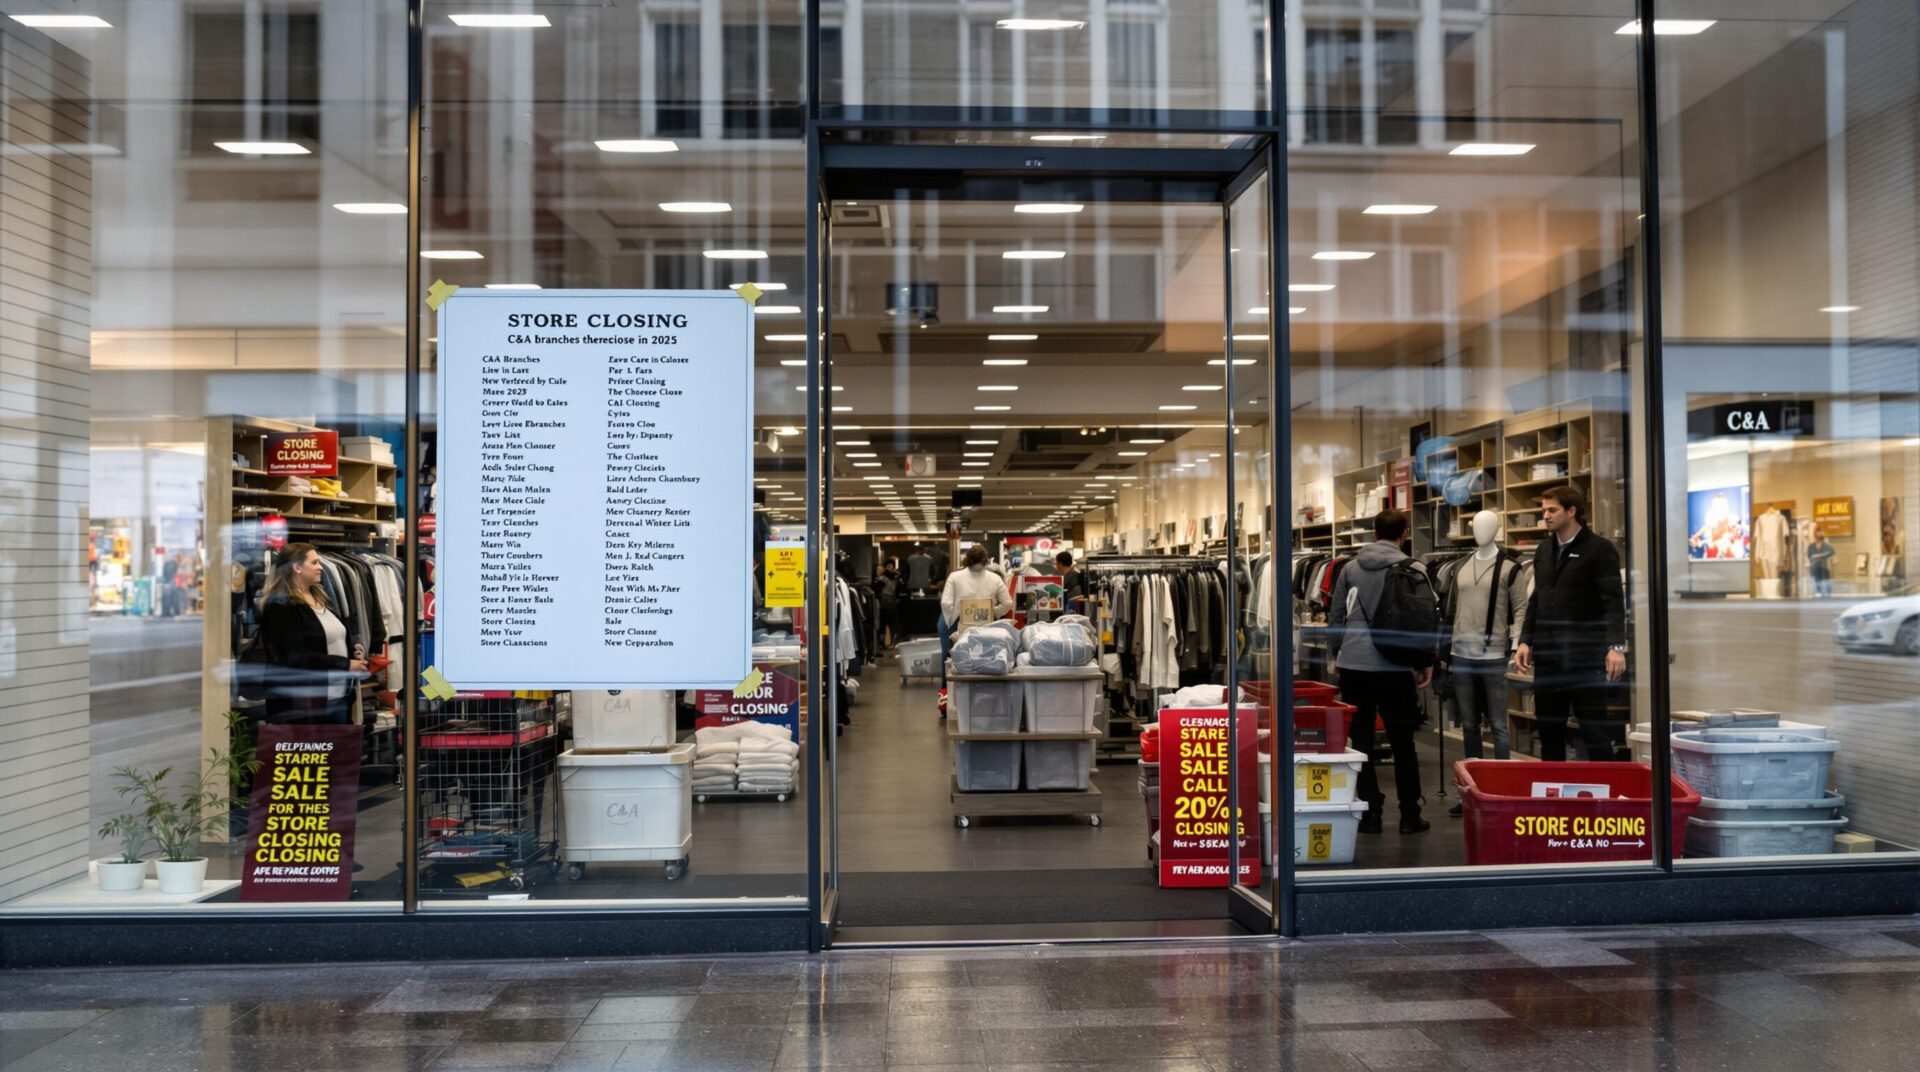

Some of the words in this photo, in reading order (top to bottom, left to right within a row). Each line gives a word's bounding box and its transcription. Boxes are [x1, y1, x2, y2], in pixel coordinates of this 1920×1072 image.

[508, 313, 578, 328] STORE
[587, 313, 689, 329] CLOSING
[508, 335, 531, 344] C&A
[535, 334, 580, 345] branches
[638, 335, 648, 344] in
[652, 335, 677, 345] 2025
[537, 377, 546, 386] by
[1727, 411, 1770, 430] C&A
[283, 438, 318, 449] STORE
[277, 450, 324, 460] CLOSING
[730, 703, 789, 715] CLOSING
[1180, 742, 1229, 758] SALE
[274, 753, 330, 765] STARRE
[272, 766, 331, 782] SALE
[1180, 760, 1229, 775] SALE
[271, 784, 330, 800] SALE
[1183, 778, 1228, 793] CALL
[268, 803, 294, 814] FOR
[299, 803, 330, 814] THES
[606, 802, 639, 818] C&A
[266, 816, 331, 831] STORE
[1514, 816, 1569, 836] STORE
[1573, 817, 1646, 836] CLOSING
[257, 832, 342, 848] CLOSING
[255, 848, 341, 863] CLOSING
